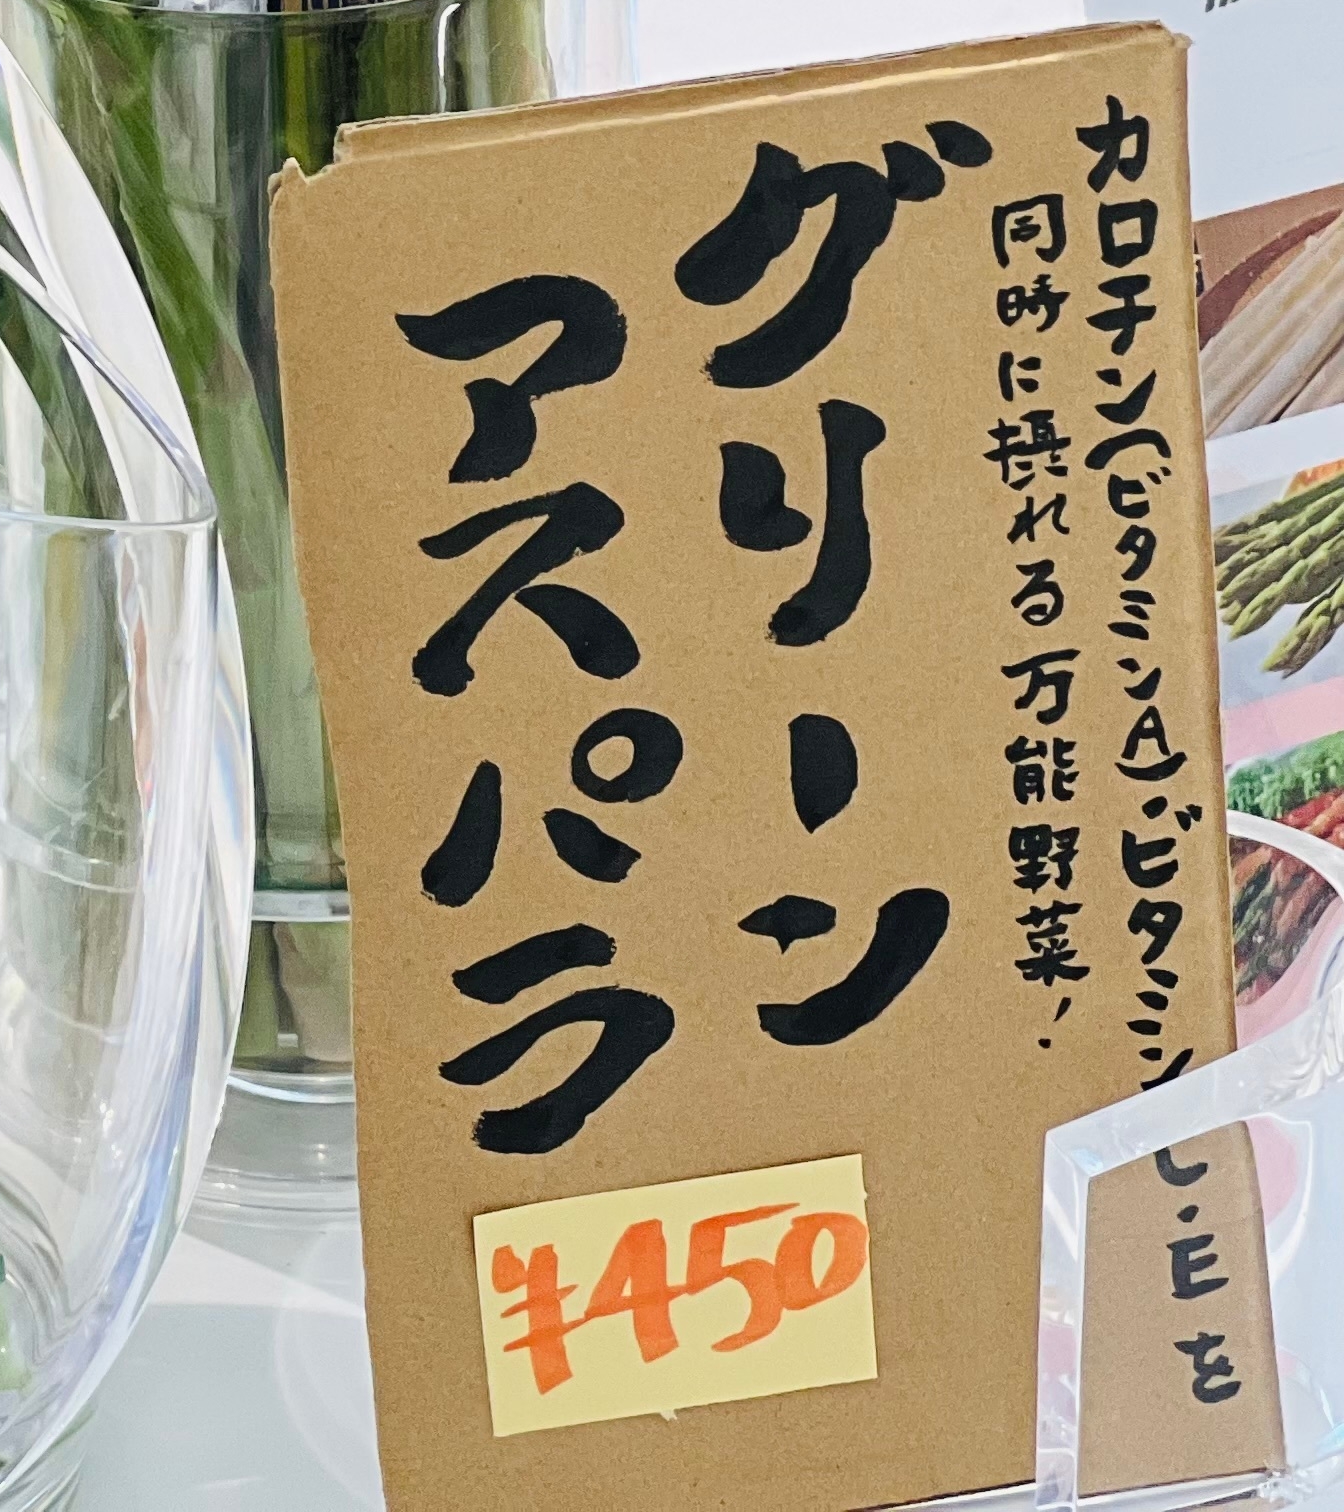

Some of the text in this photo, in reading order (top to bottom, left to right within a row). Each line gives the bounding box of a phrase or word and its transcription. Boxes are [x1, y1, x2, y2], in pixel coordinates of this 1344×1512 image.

[394, 274, 683, 1155] アスパラ
[674, 120, 994, 1047] グリーン
[490, 1202, 869, 1395] ¥450
